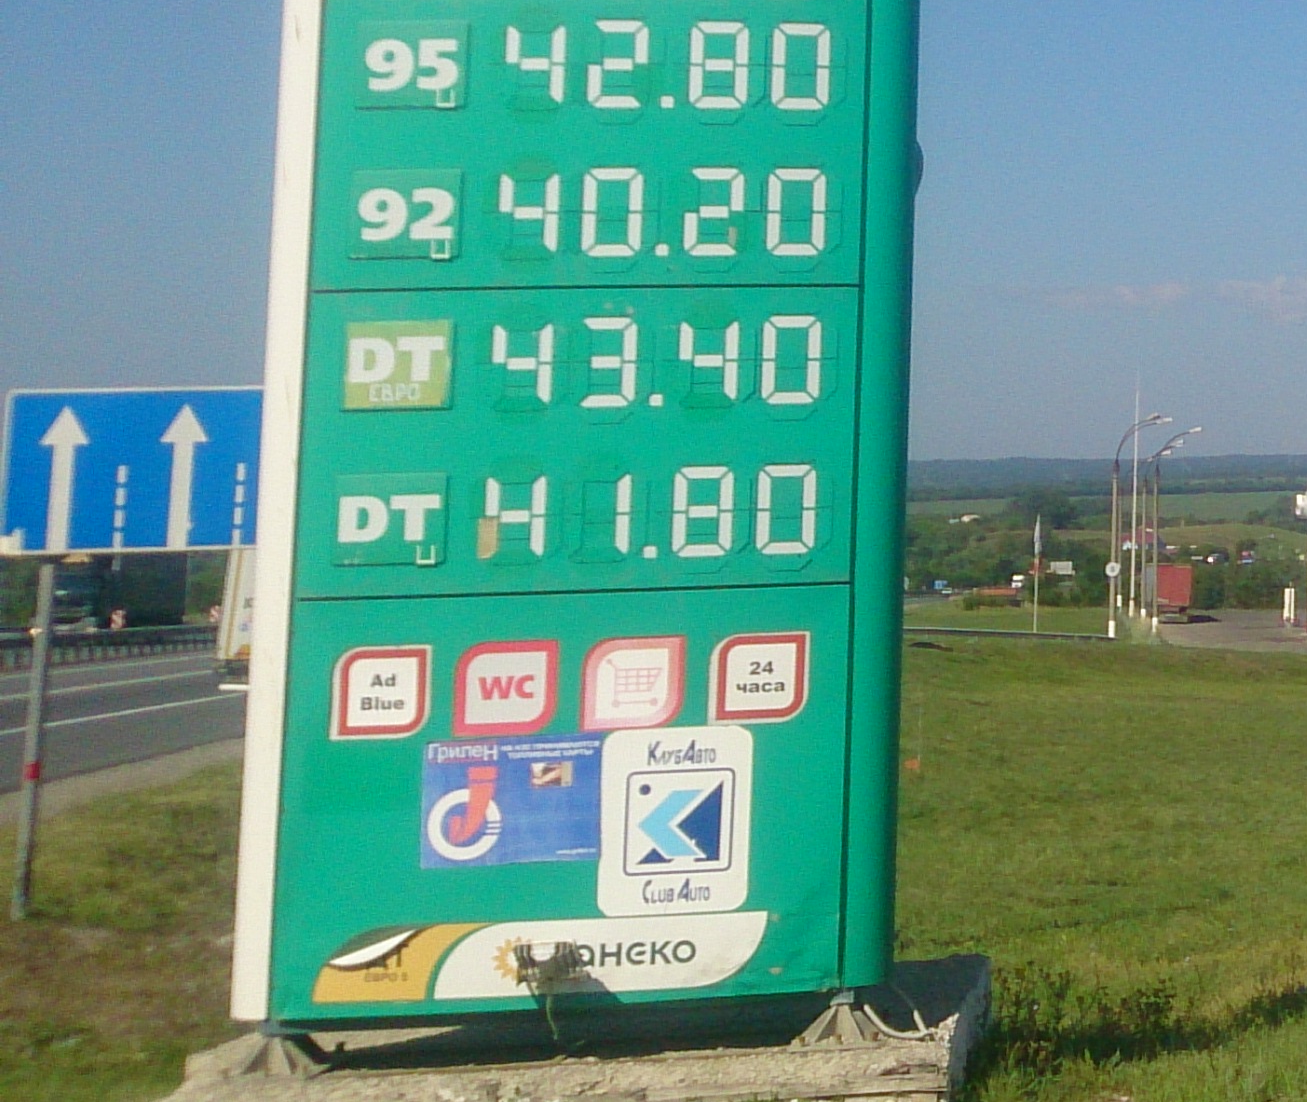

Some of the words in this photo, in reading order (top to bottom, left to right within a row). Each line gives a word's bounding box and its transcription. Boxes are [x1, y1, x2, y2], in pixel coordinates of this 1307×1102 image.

[364, 38, 460, 92] 95
[504, 19, 832, 110] 42.80
[357, 187, 455, 241] 92
[498, 166, 828, 258] 40.20
[348, 335, 445, 384] DT
[491, 314, 822, 408] 43.40
[336, 493, 442, 543] DT
[370, 673, 397, 688] Ad
[749, 661, 774, 675] 24
[478, 674, 535, 701] WC
[736, 681, 786, 694] часа
[360, 696, 405, 711] Blue
